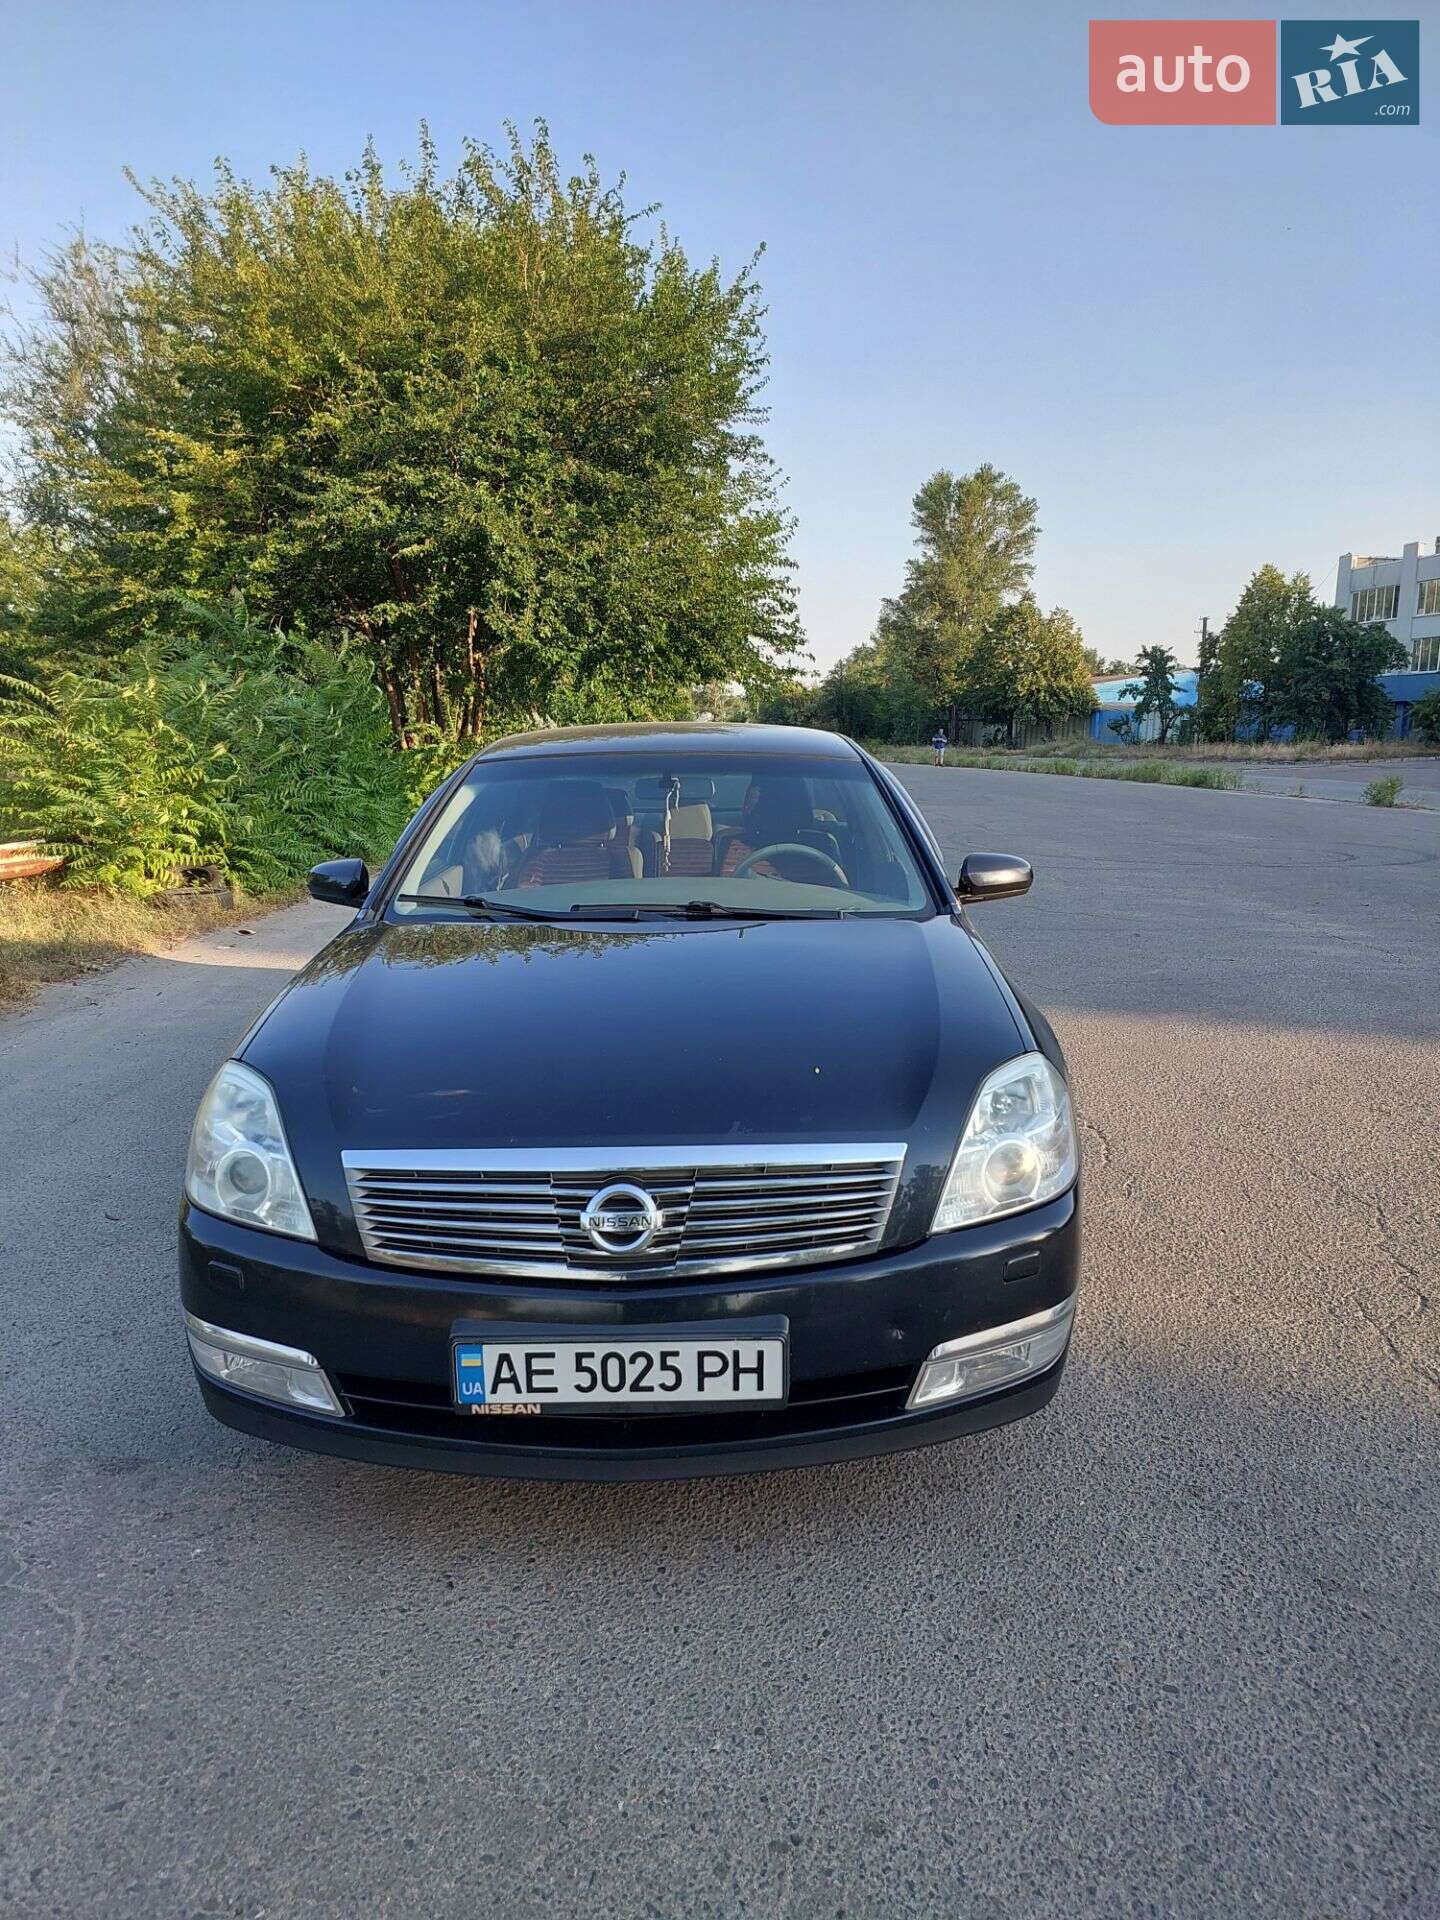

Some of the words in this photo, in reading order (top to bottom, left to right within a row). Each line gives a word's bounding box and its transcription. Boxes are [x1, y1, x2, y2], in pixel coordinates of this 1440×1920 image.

[588, 1215, 652, 1227] NISSAN
[490, 1351, 558, 1394] AE
[573, 1350, 683, 1393] 5025
[697, 1349, 765, 1392] PH
[462, 1381, 483, 1396] UA
[471, 1403, 541, 1415] NISSAN
